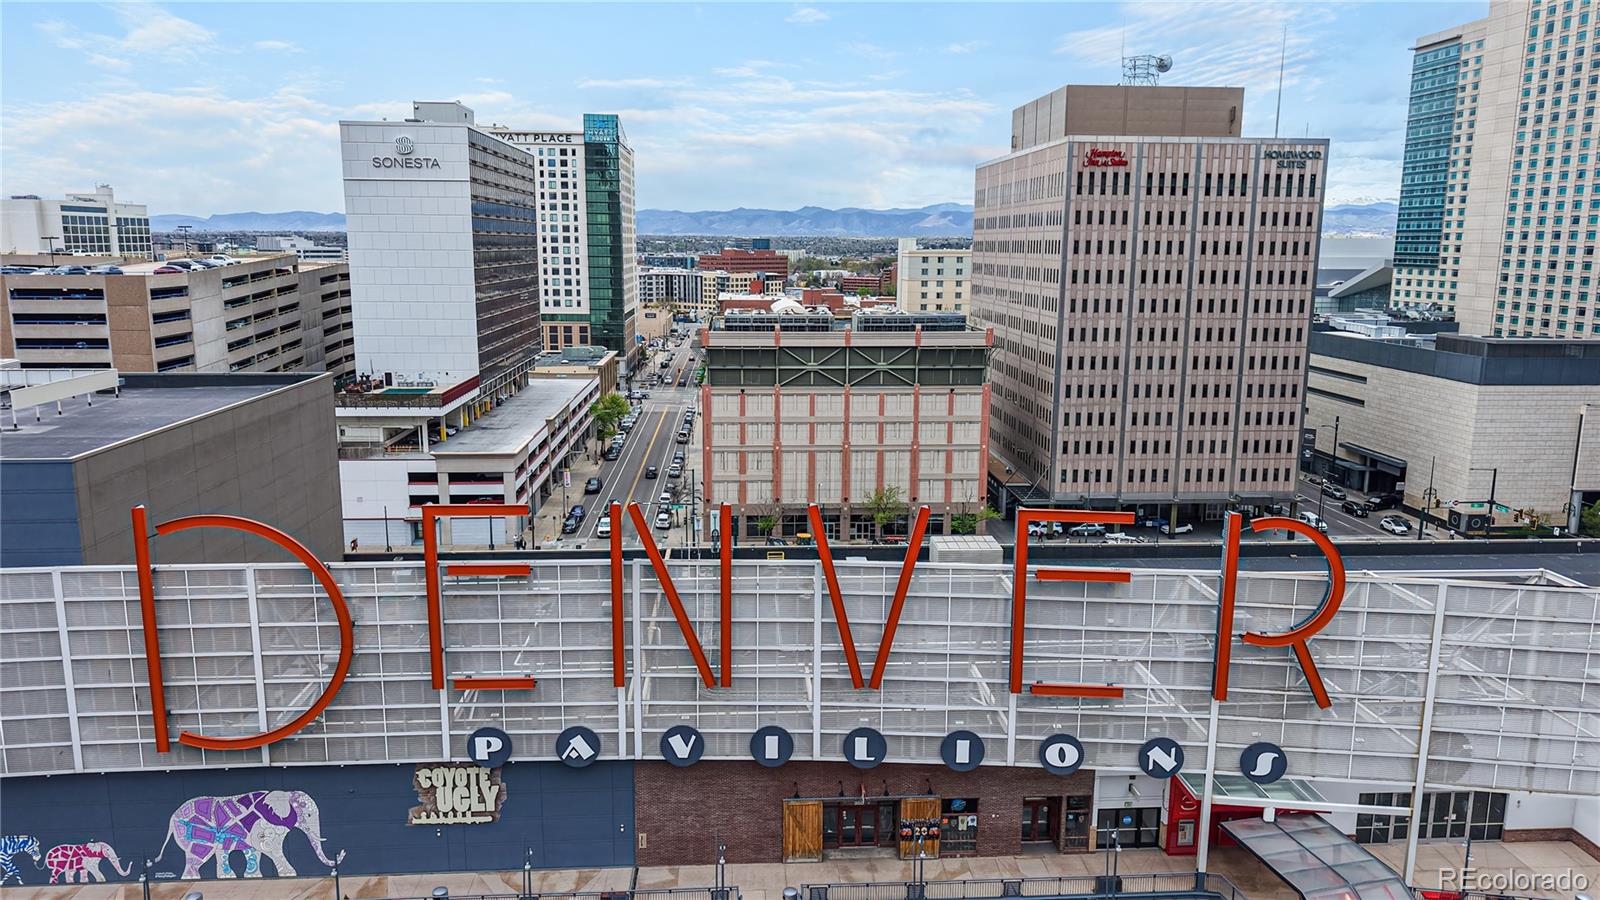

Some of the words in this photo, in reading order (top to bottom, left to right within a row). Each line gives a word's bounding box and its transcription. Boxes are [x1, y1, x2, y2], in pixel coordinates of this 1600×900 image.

[533, 134, 572, 143] PLACE
[1086, 148, 1125, 159] Hampton
[1264, 150, 1321, 159] HOMEWOOD
[372, 156, 441, 170] SONESTA
[1277, 160, 1306, 168] SUITES
[132, 502, 1346, 753] DENVER
[474, 733, 1280, 776] PAVILIONS
[416, 767, 491, 788] COYOTE
[436, 785, 499, 812] UGLY
